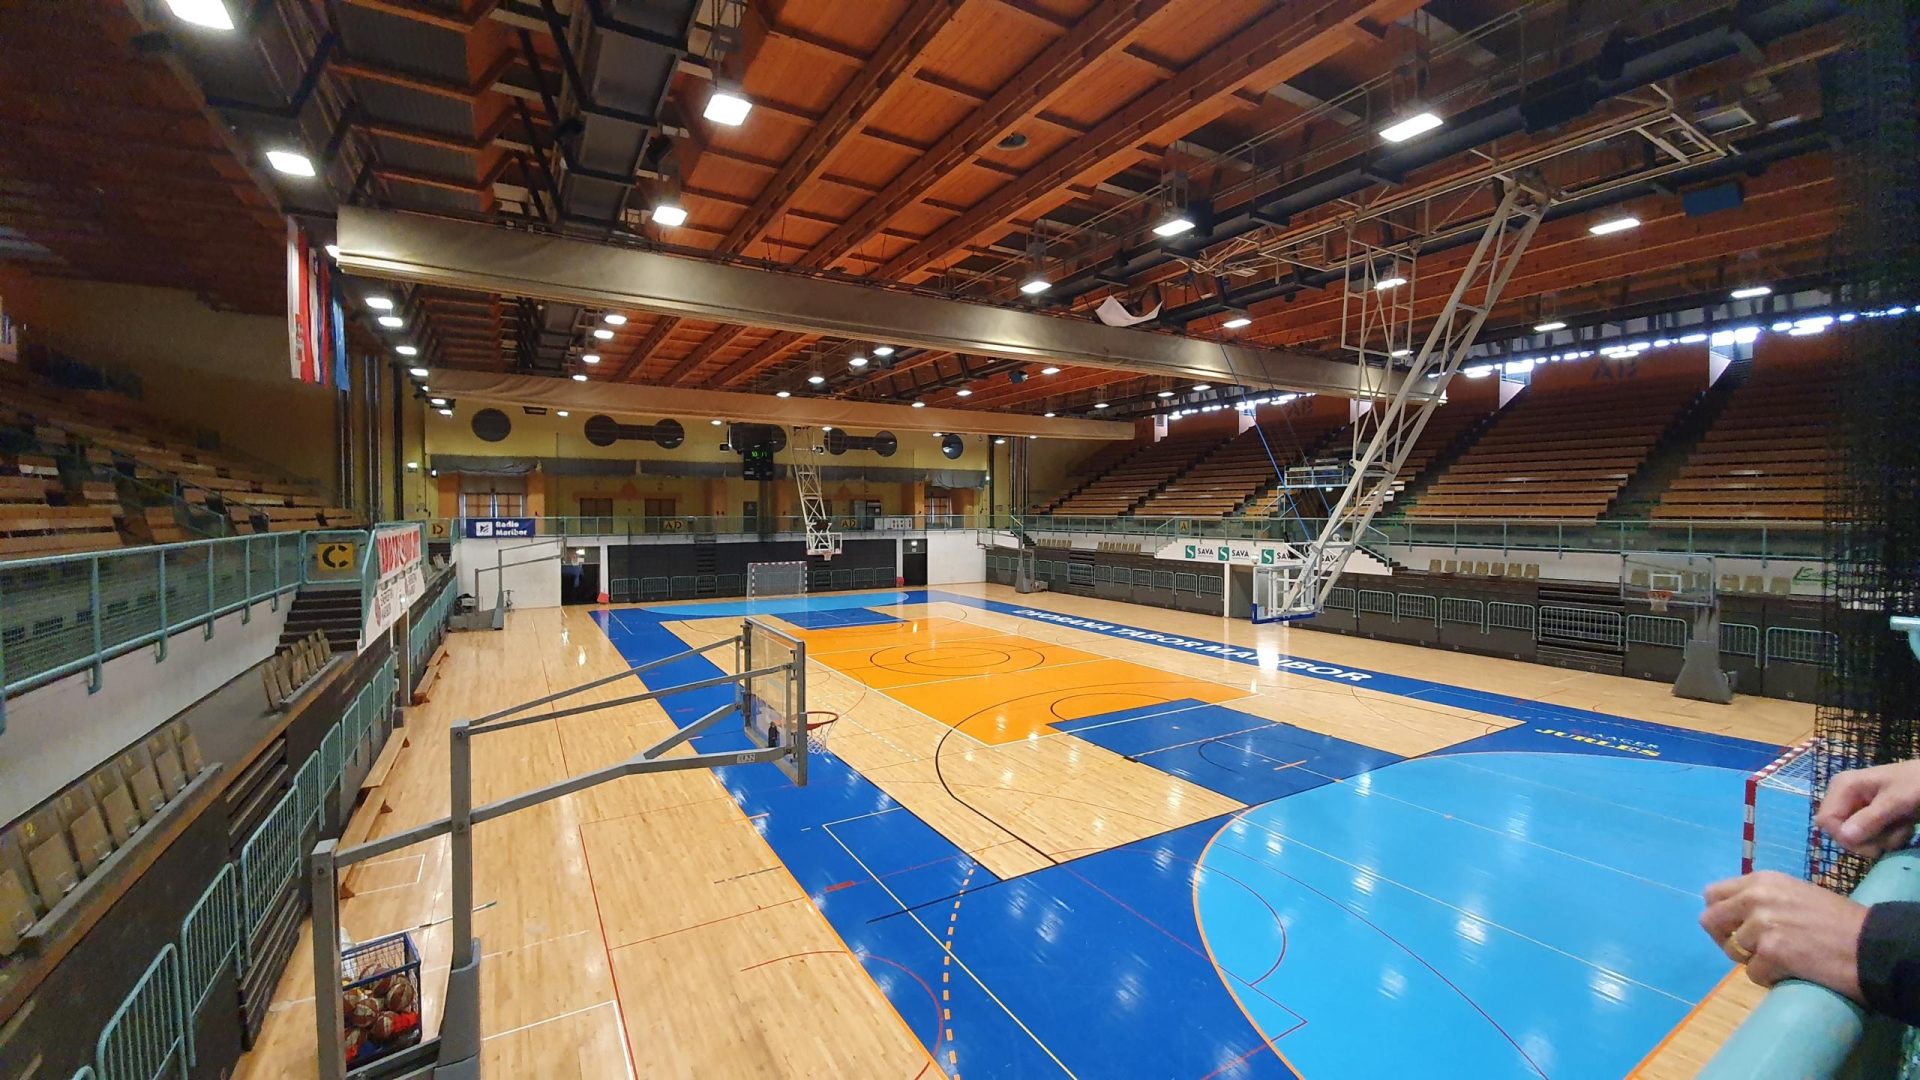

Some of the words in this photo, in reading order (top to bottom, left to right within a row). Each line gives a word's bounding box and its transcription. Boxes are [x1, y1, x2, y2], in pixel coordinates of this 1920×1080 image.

[666, 521, 681, 529] AD
[842, 519, 856, 528] AD
[433, 524, 443, 535] D
[495, 528, 528, 536] Maribor
[1197, 547, 1214, 555] SAVA
[1231, 549, 1250, 558] SAVA
[322, 544, 349, 568] C
[1111, 628, 1204, 649] TABOR
